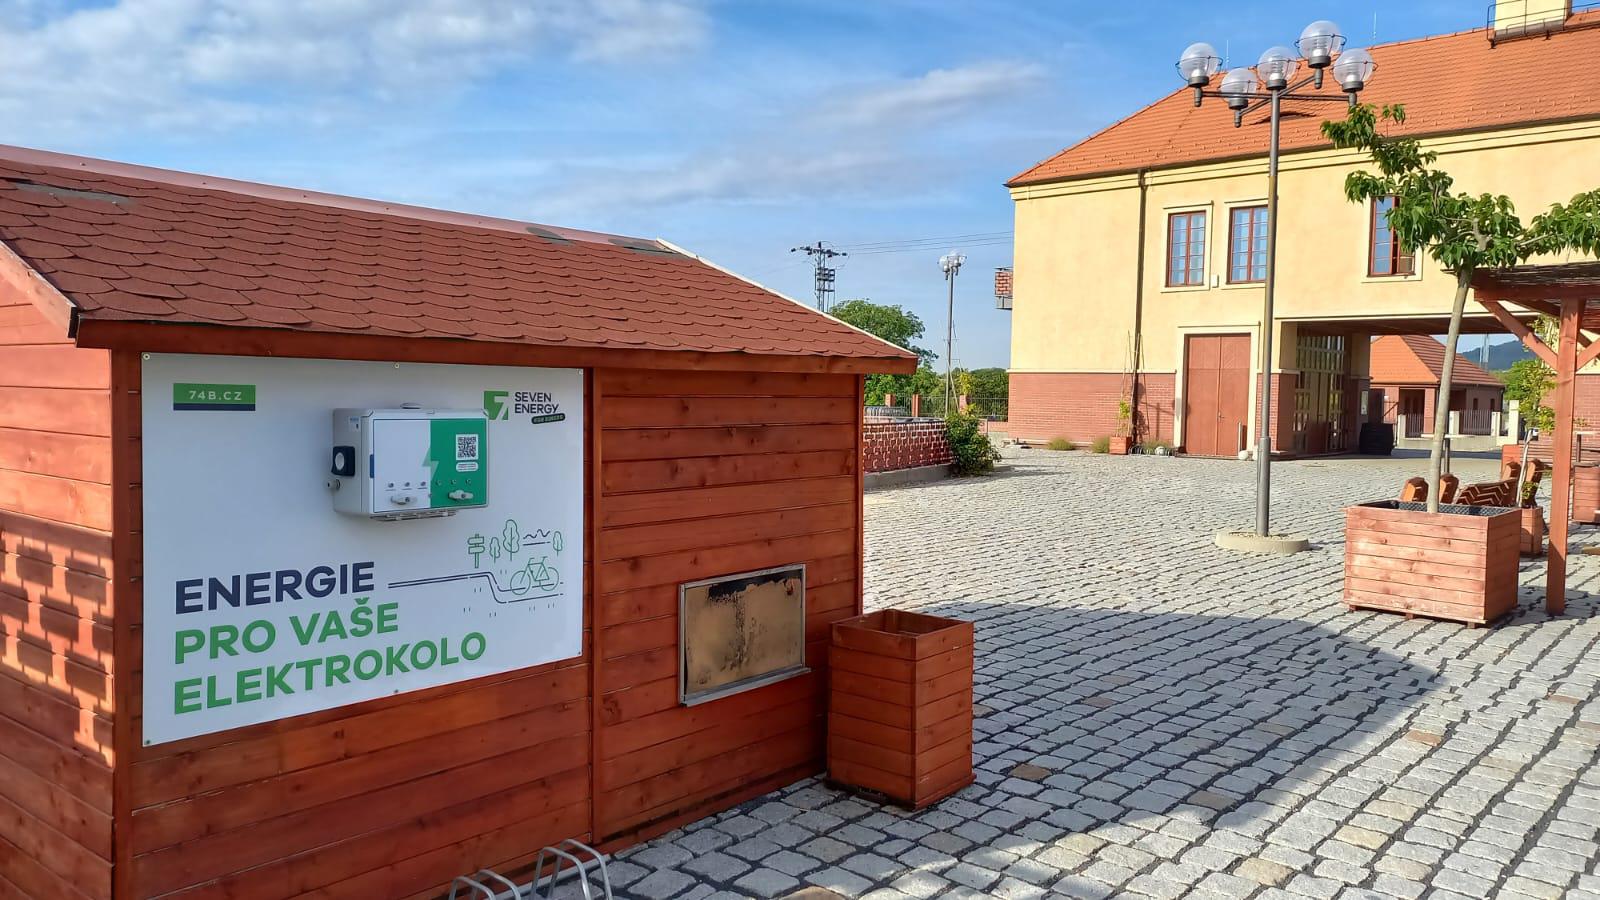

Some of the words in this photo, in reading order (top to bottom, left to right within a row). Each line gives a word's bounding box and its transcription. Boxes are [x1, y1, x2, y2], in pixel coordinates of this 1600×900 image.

[188, 390, 242, 401] 74B.CZ
[514, 403, 560, 414] ENERGY
[175, 561, 375, 615] ENERGIE
[174, 619, 277, 665] PRO
[288, 597, 399, 646] VAŠE
[174, 631, 487, 715] ELEKTROKOLO
